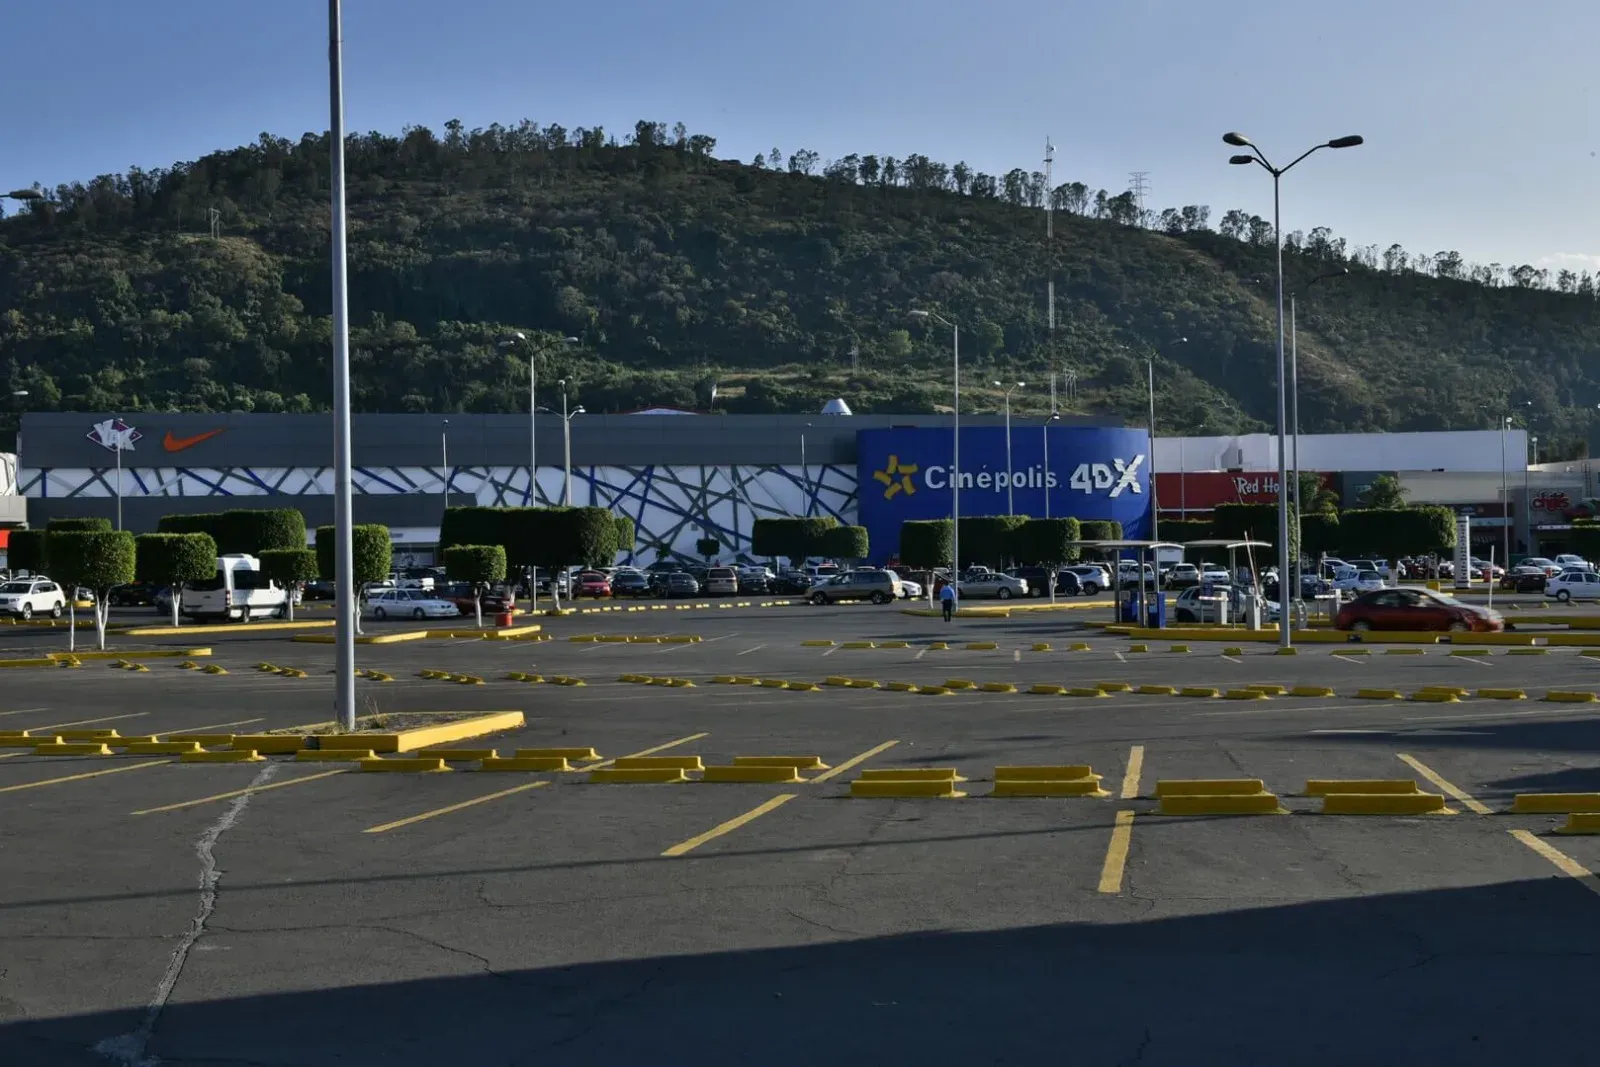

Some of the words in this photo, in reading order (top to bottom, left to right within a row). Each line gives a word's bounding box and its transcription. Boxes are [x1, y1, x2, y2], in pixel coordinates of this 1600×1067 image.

[924, 464, 1057, 492] Cinépolis
[1070, 454, 1145, 497] 4DX
[1236, 476, 1259, 495] Red
